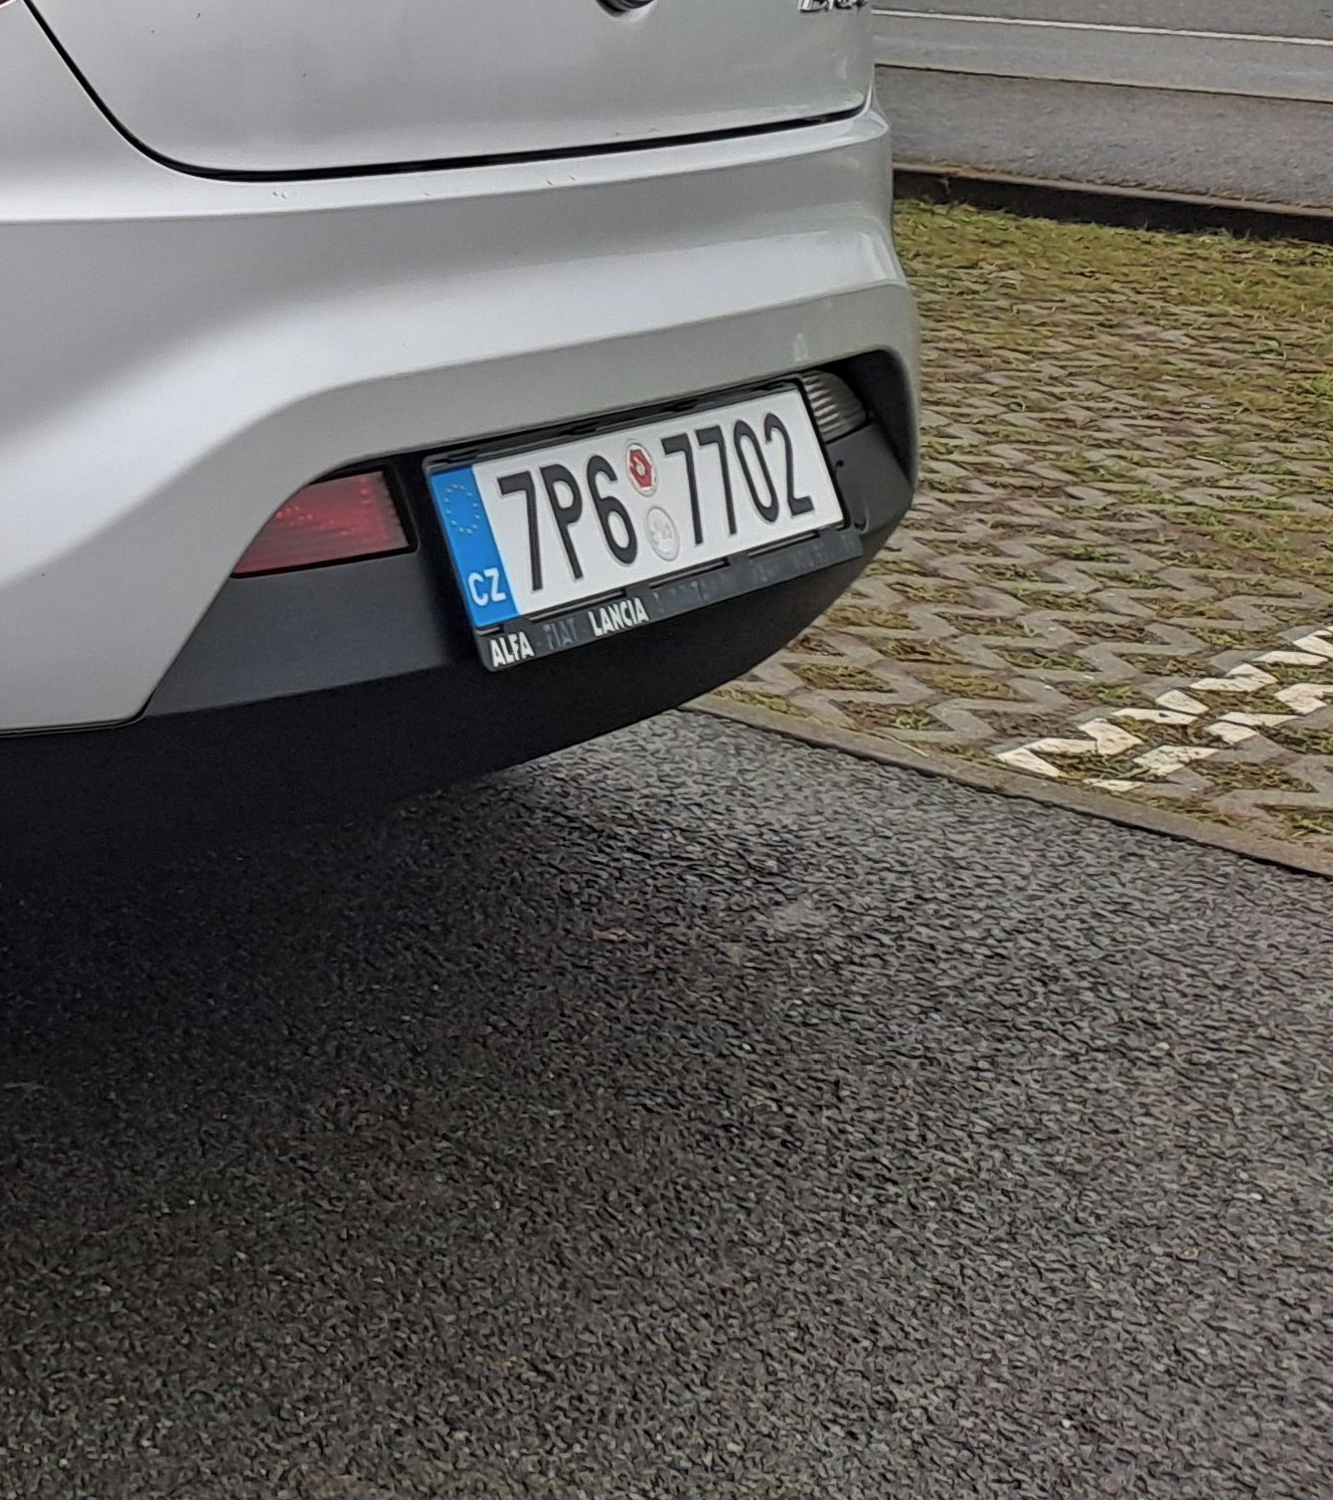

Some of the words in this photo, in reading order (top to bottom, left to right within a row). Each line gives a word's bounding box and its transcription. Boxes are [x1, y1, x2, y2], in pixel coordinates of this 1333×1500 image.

[497, 454, 638, 592] 7P6
[662, 412, 815, 547] 7702
[468, 566, 507, 607] CZ
[489, 631, 535, 668] ALFA
[587, 596, 651, 638] LANCIA
